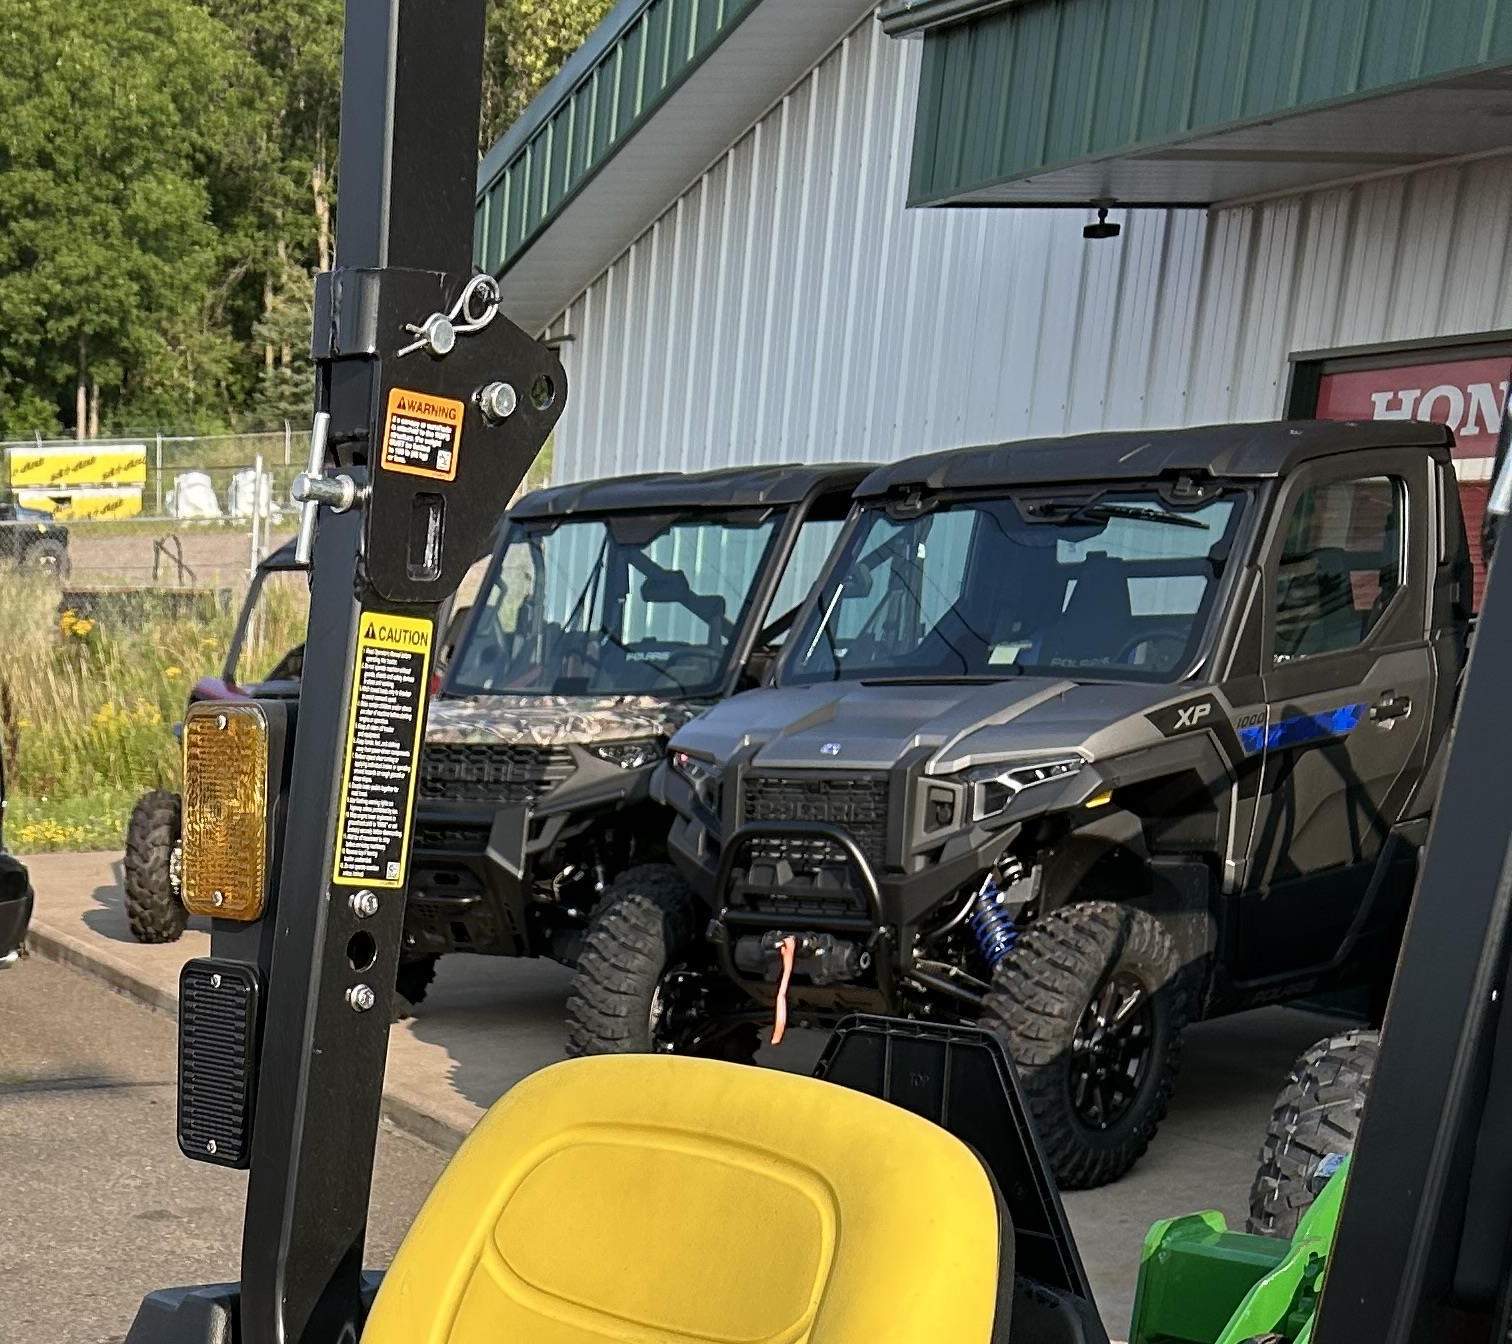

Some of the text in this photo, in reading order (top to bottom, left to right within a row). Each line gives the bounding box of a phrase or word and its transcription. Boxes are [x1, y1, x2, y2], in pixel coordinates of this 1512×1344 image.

[407, 400, 457, 420] WARNING
[378, 626, 429, 647] CAUTION
[1173, 703, 1211, 729] XP
[1238, 712, 1265, 728] 1000
